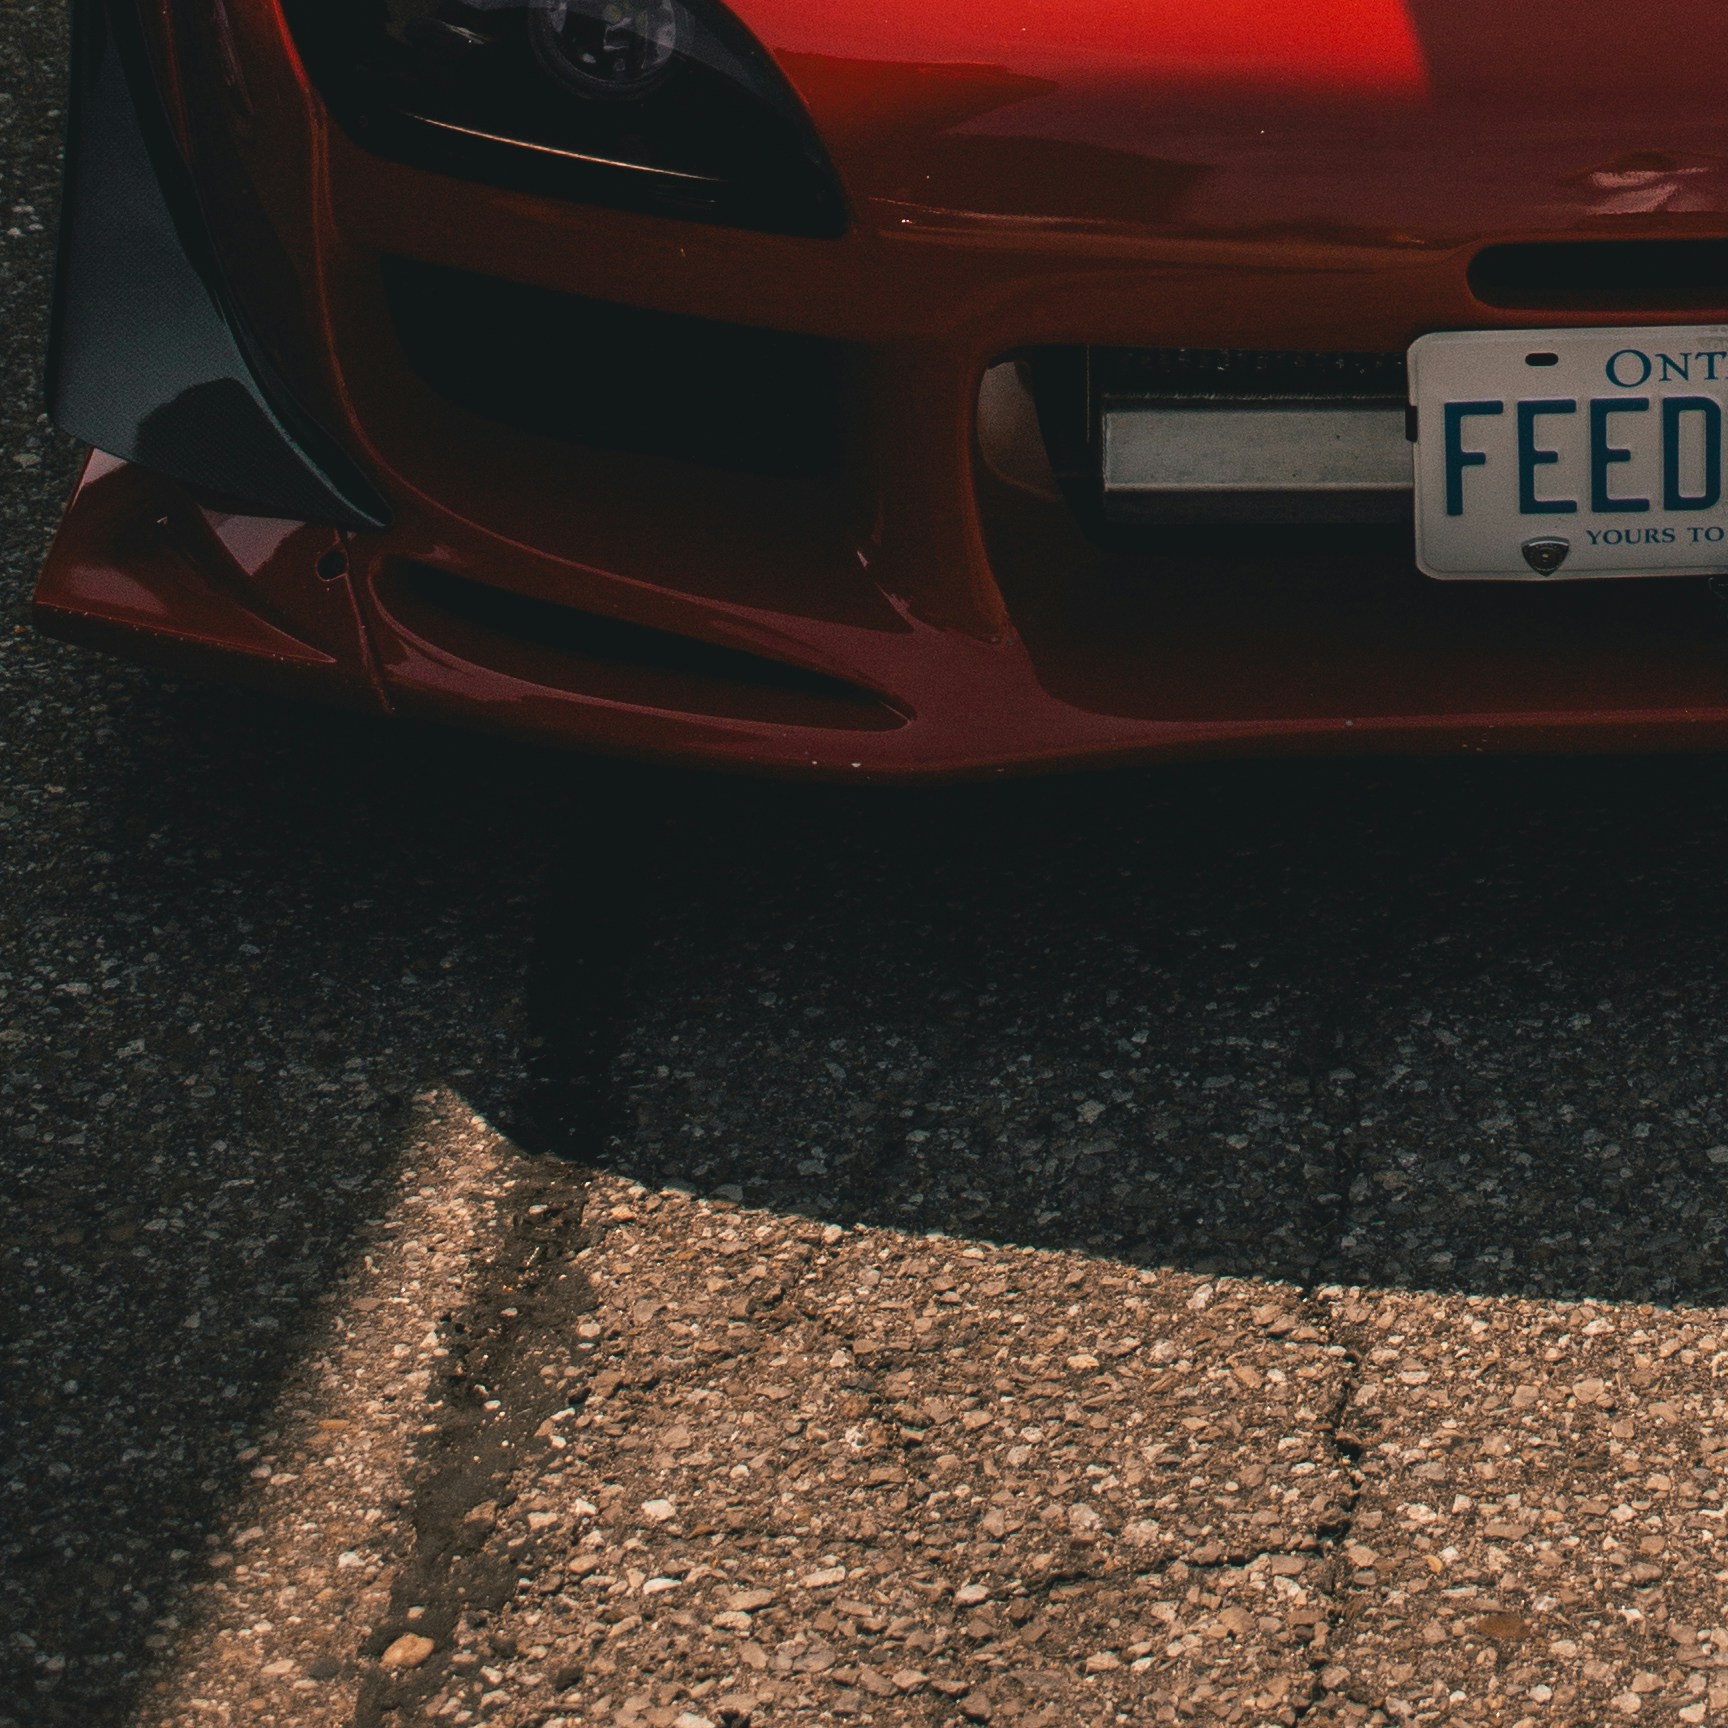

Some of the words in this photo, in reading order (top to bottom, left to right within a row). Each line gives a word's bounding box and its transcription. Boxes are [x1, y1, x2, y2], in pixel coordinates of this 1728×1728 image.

[1443, 395, 1723, 517] FEED
[1586, 527, 1675, 545] YOURS
[1687, 526, 1724, 543] TO
